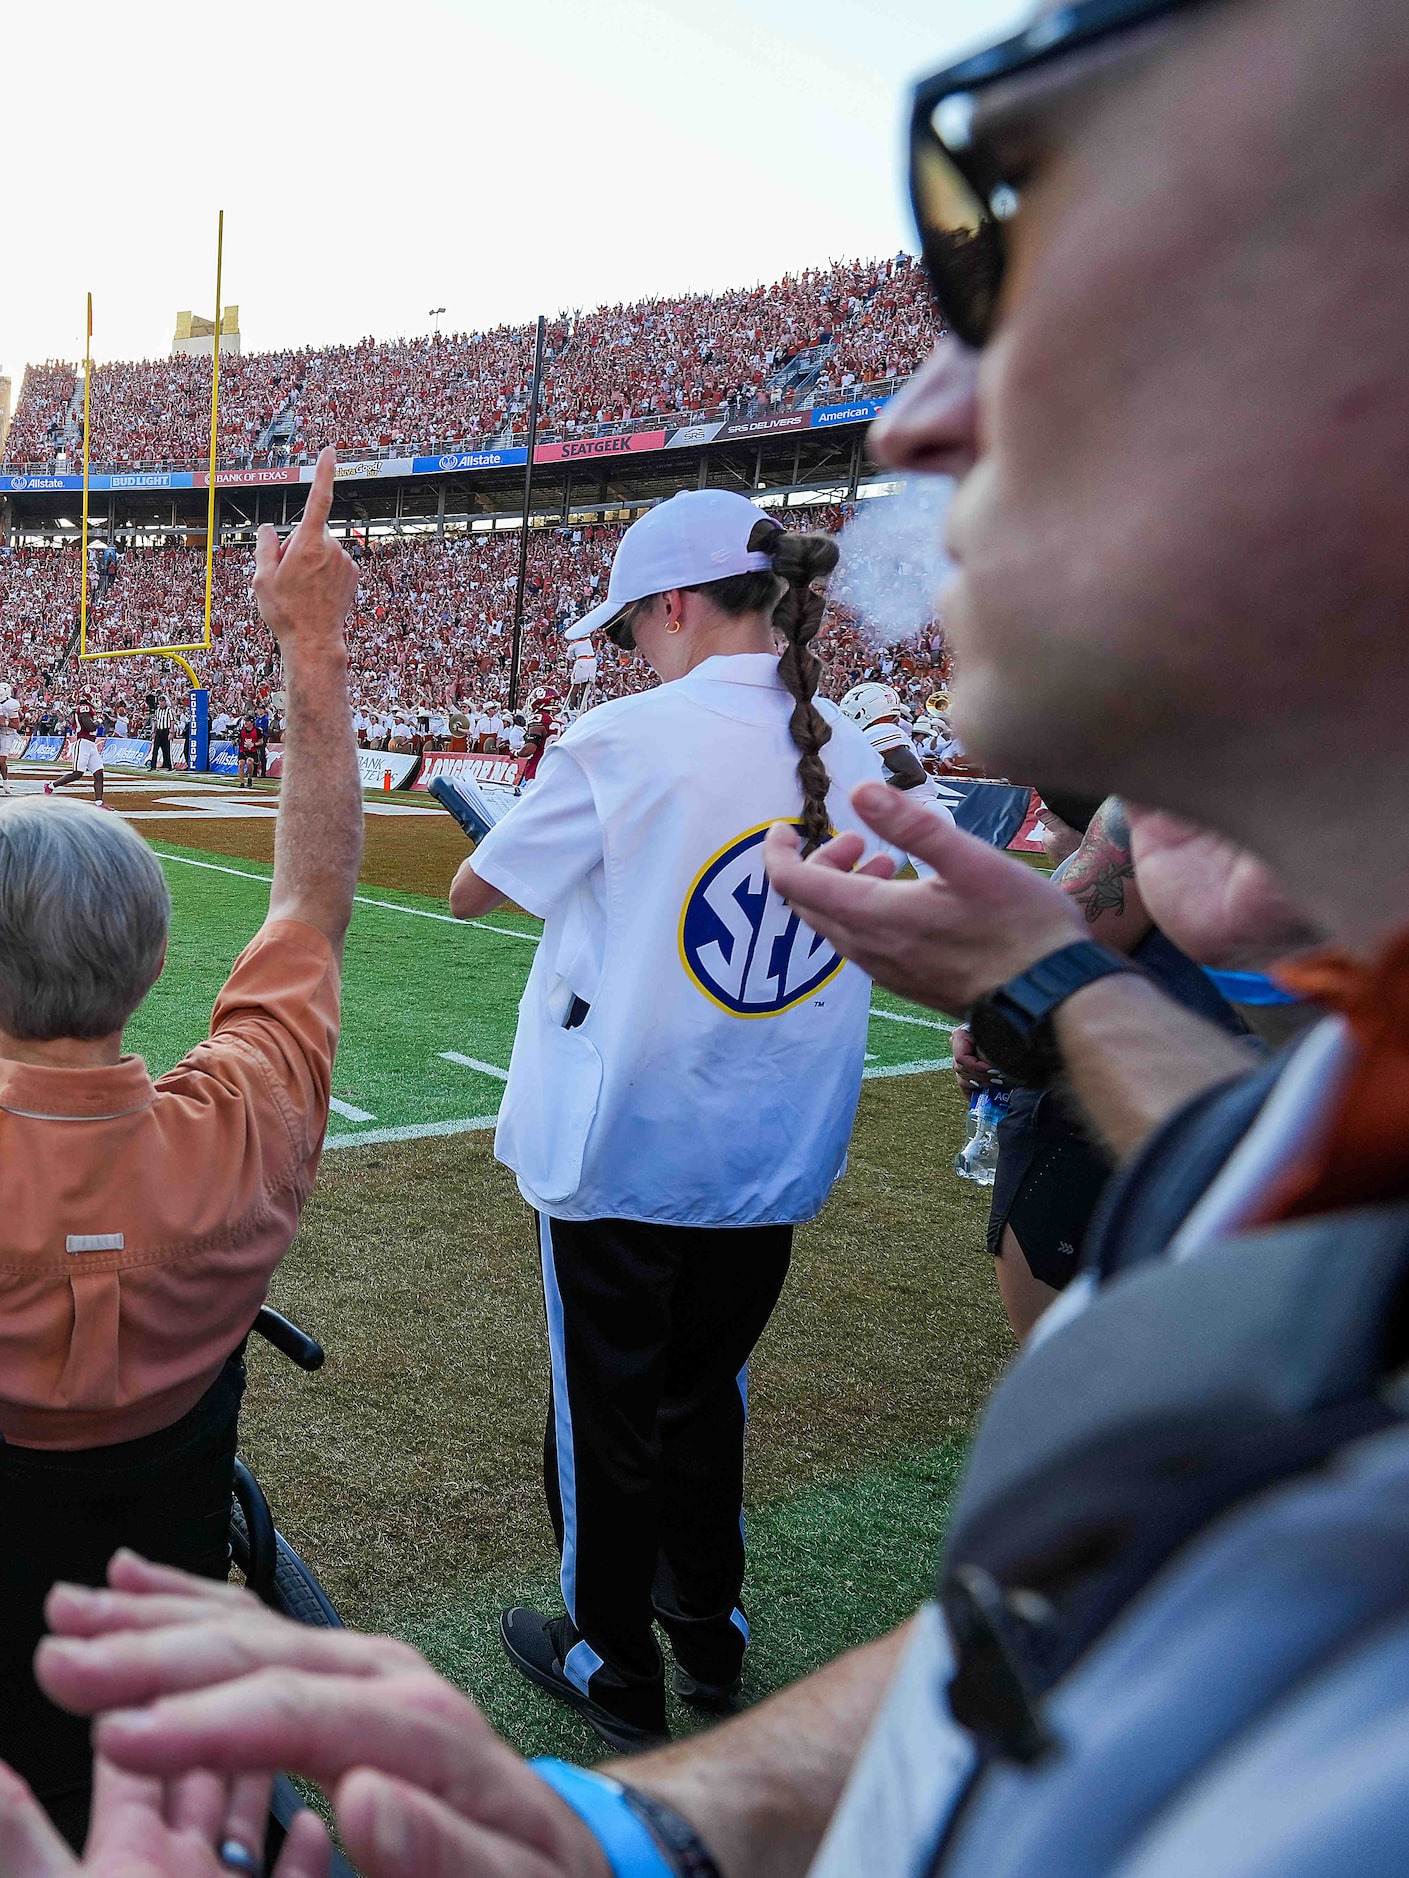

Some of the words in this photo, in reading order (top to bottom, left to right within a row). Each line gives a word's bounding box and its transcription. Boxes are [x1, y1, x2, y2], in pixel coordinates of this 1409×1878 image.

[818, 406, 869, 423] American
[727, 425, 748, 435] SRS
[748, 416, 802, 432] DELIVERS
[561, 436, 632, 459] SEATGEEK
[458, 454, 501, 467] Allstate
[27, 478, 64, 488] Allstate
[112, 476, 135, 486] BUD
[136, 475, 168, 486] LIGHT
[217, 473, 242, 483] BANK
[244, 472, 256, 482] OF
[257, 470, 288, 481] TEXAS
[79, 705, 90, 713] 20
